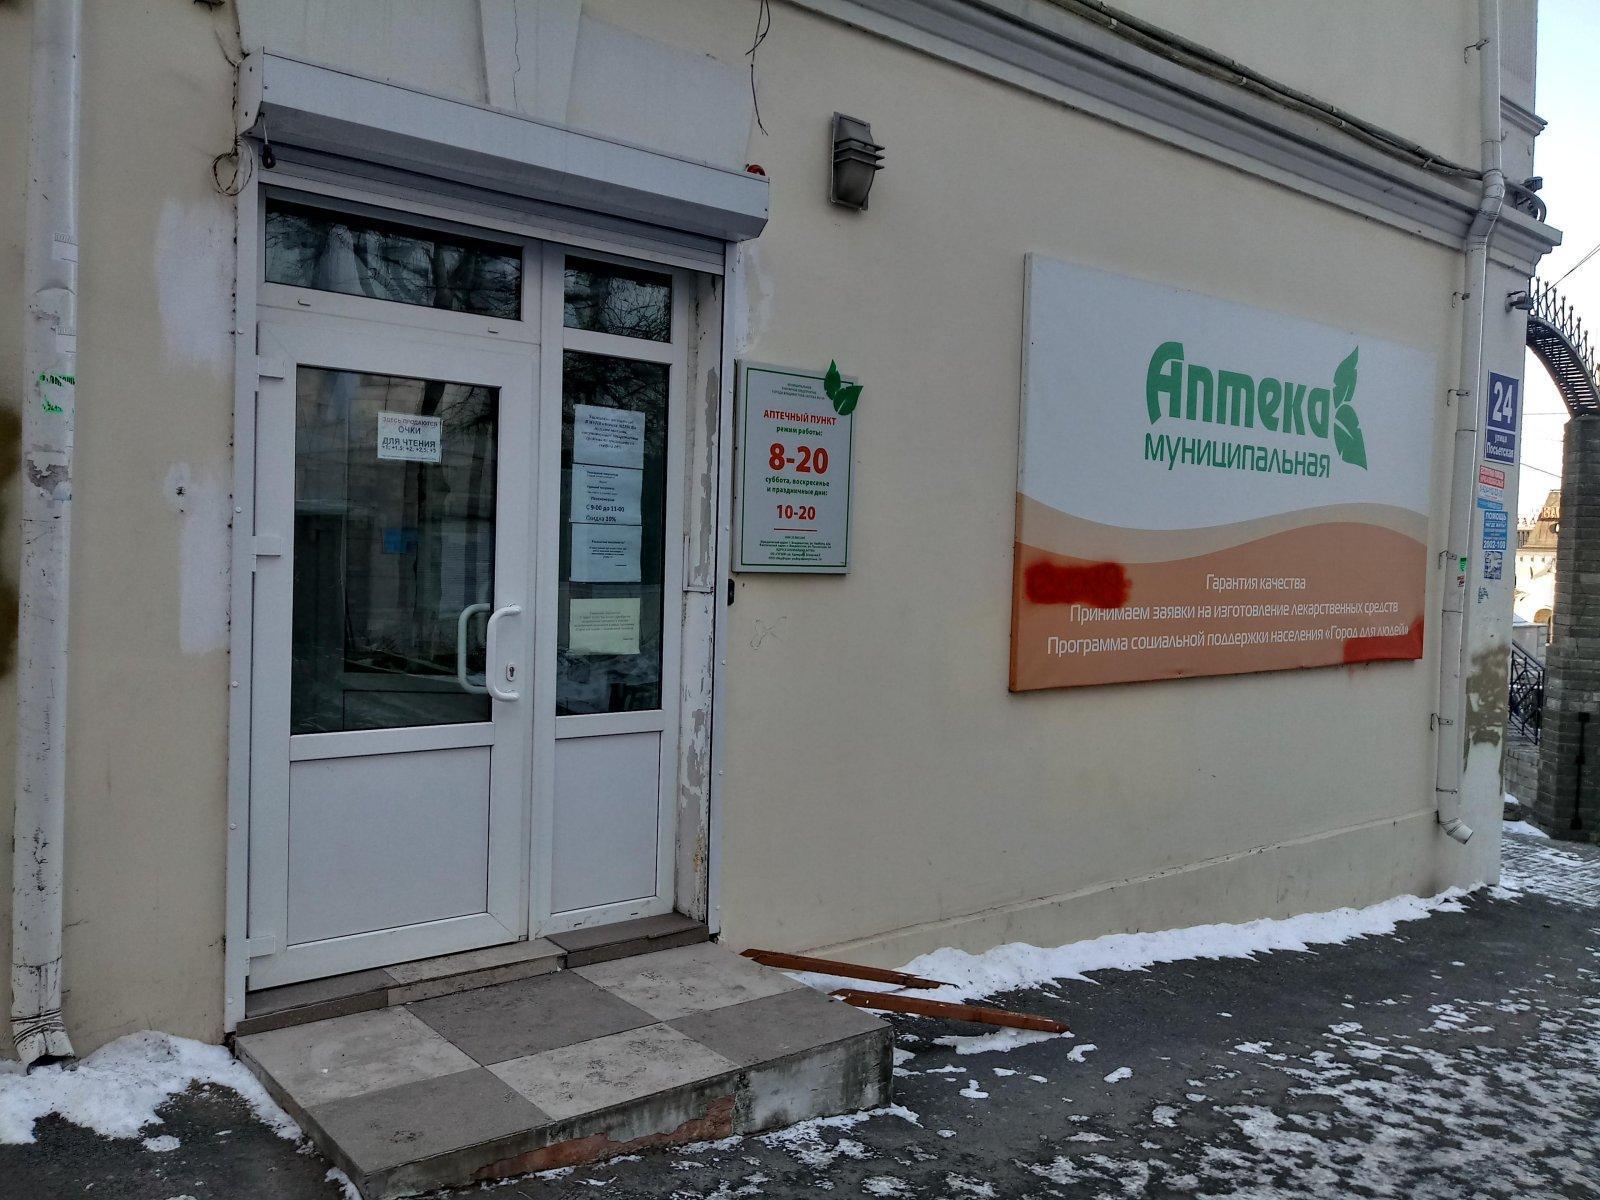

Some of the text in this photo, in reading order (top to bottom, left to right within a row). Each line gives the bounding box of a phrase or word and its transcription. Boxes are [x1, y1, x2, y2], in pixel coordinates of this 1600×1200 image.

[1146, 341, 1331, 438] Аптека
[1492, 381, 1513, 424] 24
[763, 409, 837, 426] АПТЕЧНЫЙ ПУНКТ
[398, 425, 421, 435] ОЧКИ
[776, 425, 823, 436] режим работы:
[382, 437, 436, 448] ДЛЯ ЧТЕНИЯ
[768, 442, 829, 475] 8-20
[1144, 432, 1331, 478] муниципальная
[765, 476, 792, 485] суббота,
[771, 486, 813, 496] праздничные
[814, 488, 828, 497] дни:
[777, 504, 816, 520] 10-20
[1206, 573, 1306, 593] Гарантия качества
[1070, 599, 1399, 625] Принимаем заявки на изготовление лекарственных средств
[1047, 635, 1129, 658] Программа
[1131, 629, 1205, 651] социальной
[1207, 628, 1269, 648] поддержки
[1271, 627, 1323, 643] населения
[1325, 624, 1359, 641] «Город
[1359, 625, 1376, 638] для
